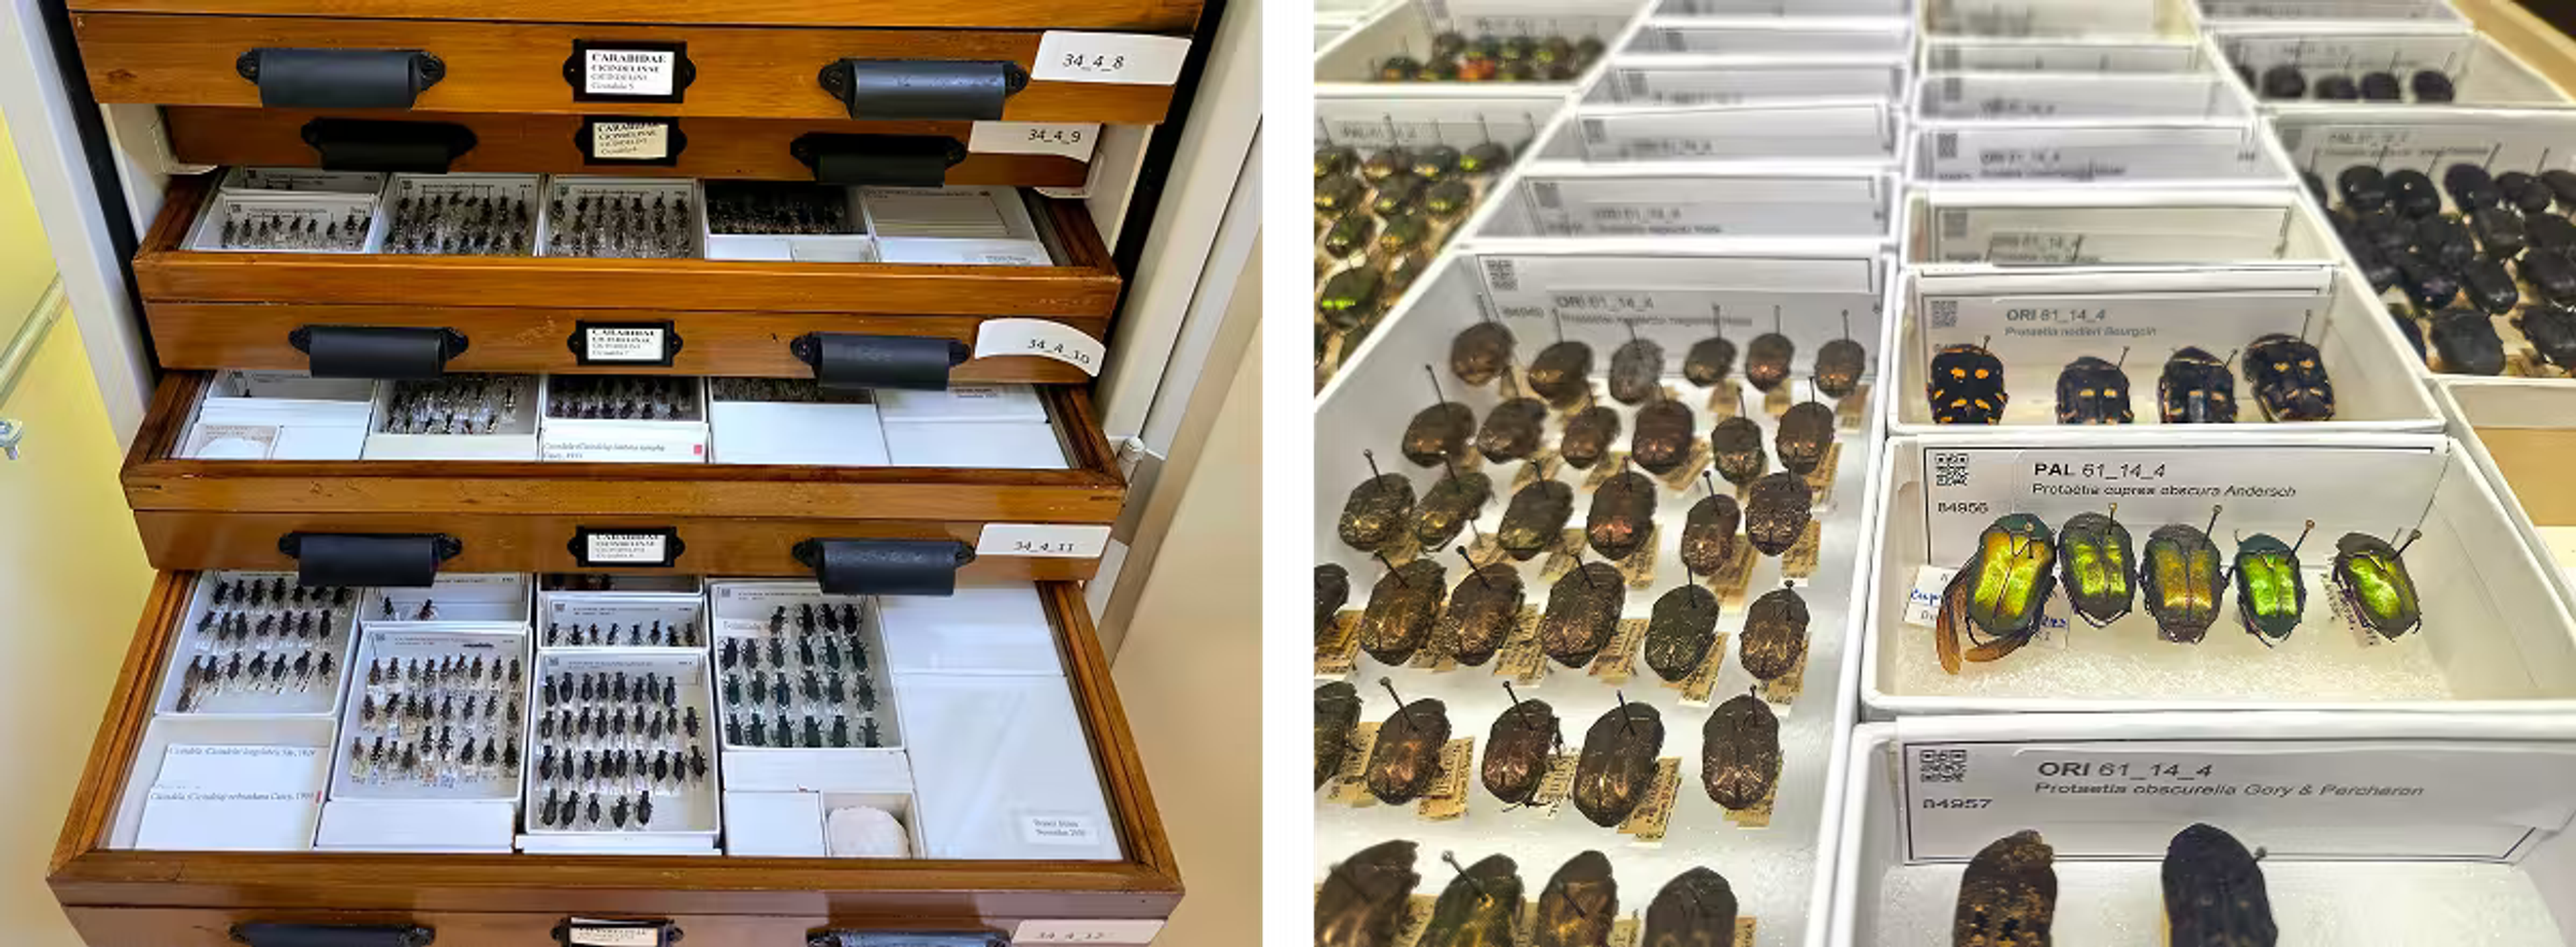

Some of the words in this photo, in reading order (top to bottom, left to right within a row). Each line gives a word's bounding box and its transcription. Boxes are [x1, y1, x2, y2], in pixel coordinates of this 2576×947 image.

[1062, 53, 1124, 72] 34_4_8
[1028, 128, 1081, 145] 34_4_9
[2006, 309, 2036, 321] ORI
[2040, 309, 2106, 323] 61_14_4
[2004, 326, 2058, 336] Protaetia
[1028, 338, 1090, 364] 34_4_10
[2035, 463, 2076, 477] PAL
[2082, 463, 2166, 480] 61_14_4
[2032, 483, 2099, 495] Protaetia
[2104, 486, 2155, 497] cuprea
[2159, 485, 2220, 497] obscura
[2223, 485, 2296, 497] Andersch
[1014, 541, 1074, 552] 34_4_11
[2037, 762, 2091, 777] ORI
[2098, 762, 2213, 781] 61_14_4
[2035, 781, 2128, 795] Protaetia
[2133, 782, 2237, 796] obscurella
[2243, 783, 2294, 797] Gory
[2298, 784, 2314, 796] &
[2319, 783, 2424, 797] Percheron
